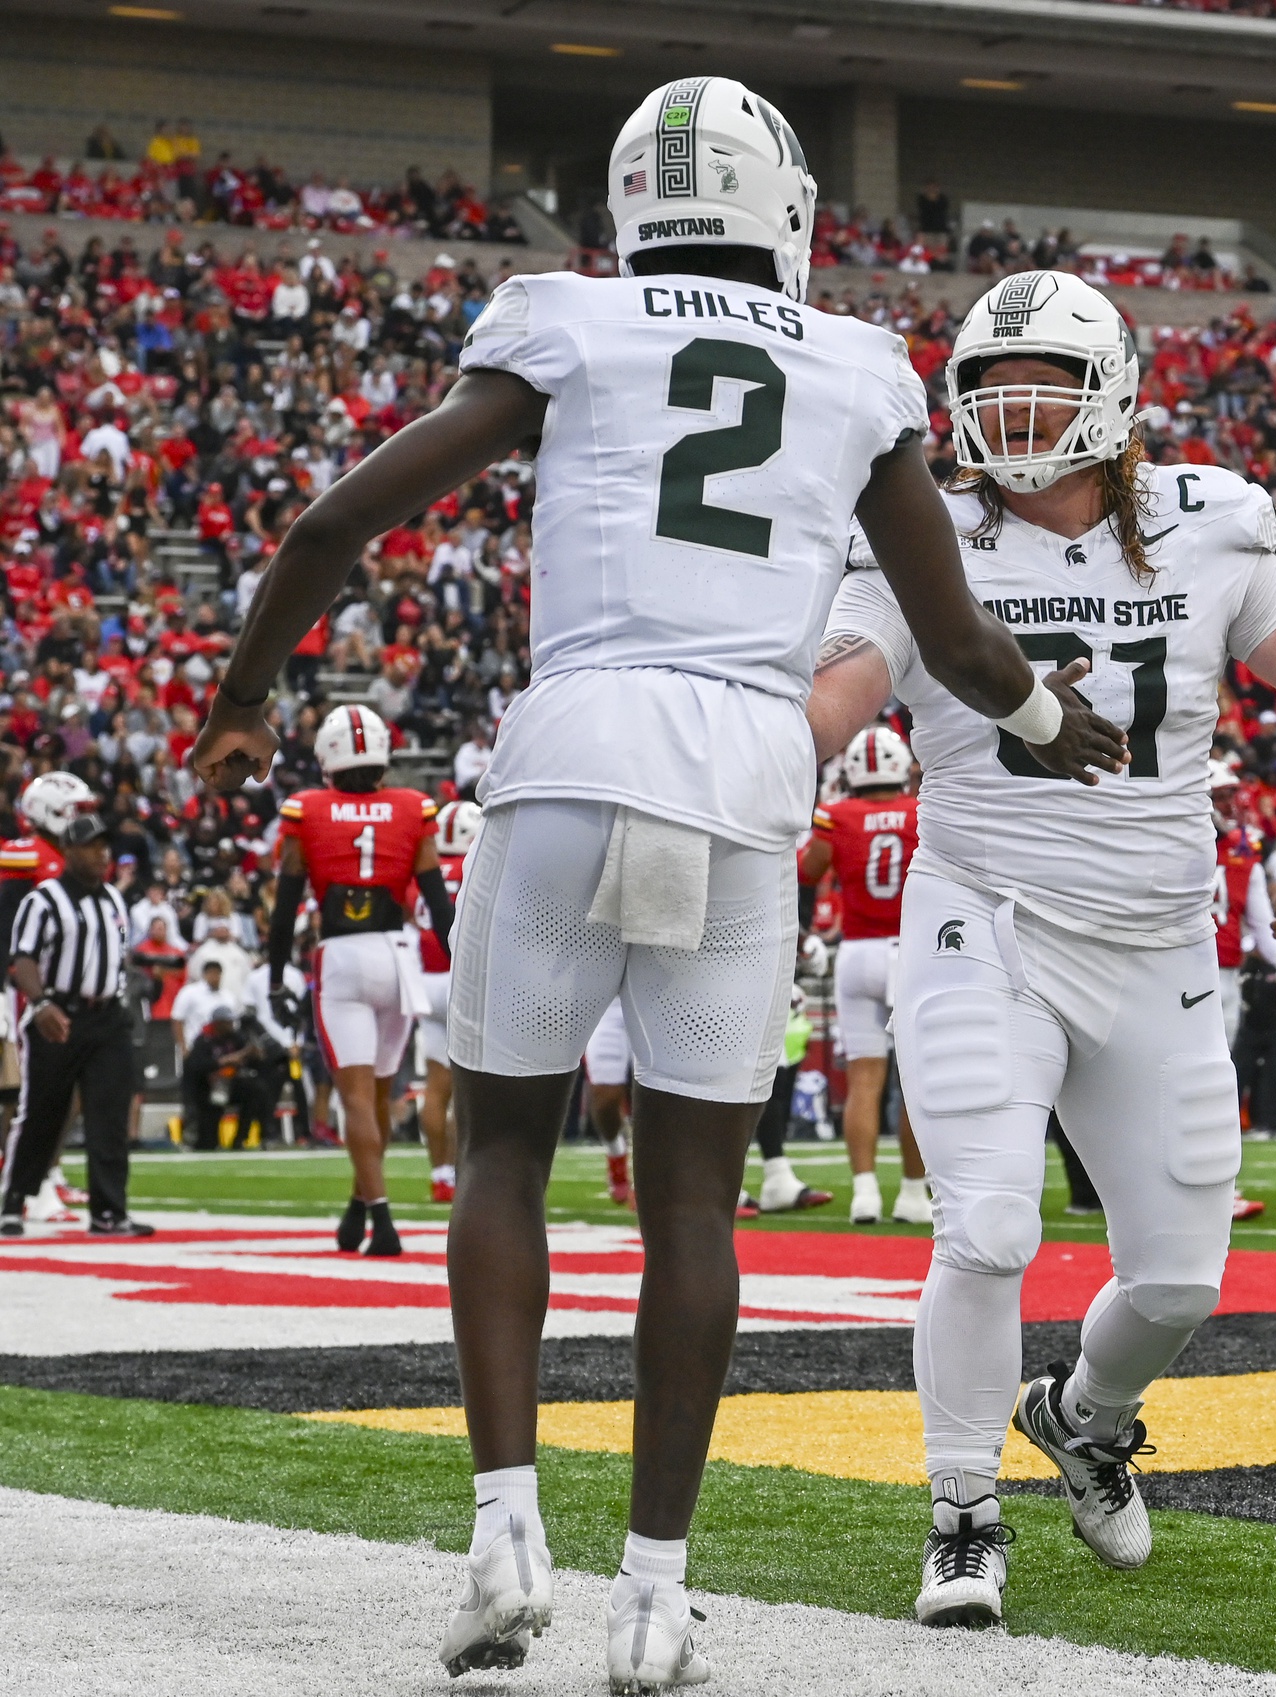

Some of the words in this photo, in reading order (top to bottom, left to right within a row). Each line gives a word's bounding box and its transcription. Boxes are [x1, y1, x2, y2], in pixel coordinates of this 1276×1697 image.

[666, 111, 687, 120] C2P
[638, 217, 725, 241] SPARTANS
[643, 287, 804, 341] CHILES
[993, 326, 1023, 337] STATE
[656, 337, 786, 558] 2
[1177, 473, 1205, 512] C
[1113, 594, 1189, 627] STATE
[330, 803, 393, 822] MILLER
[353, 825, 375, 879] 1
[866, 833, 904, 899] 0
